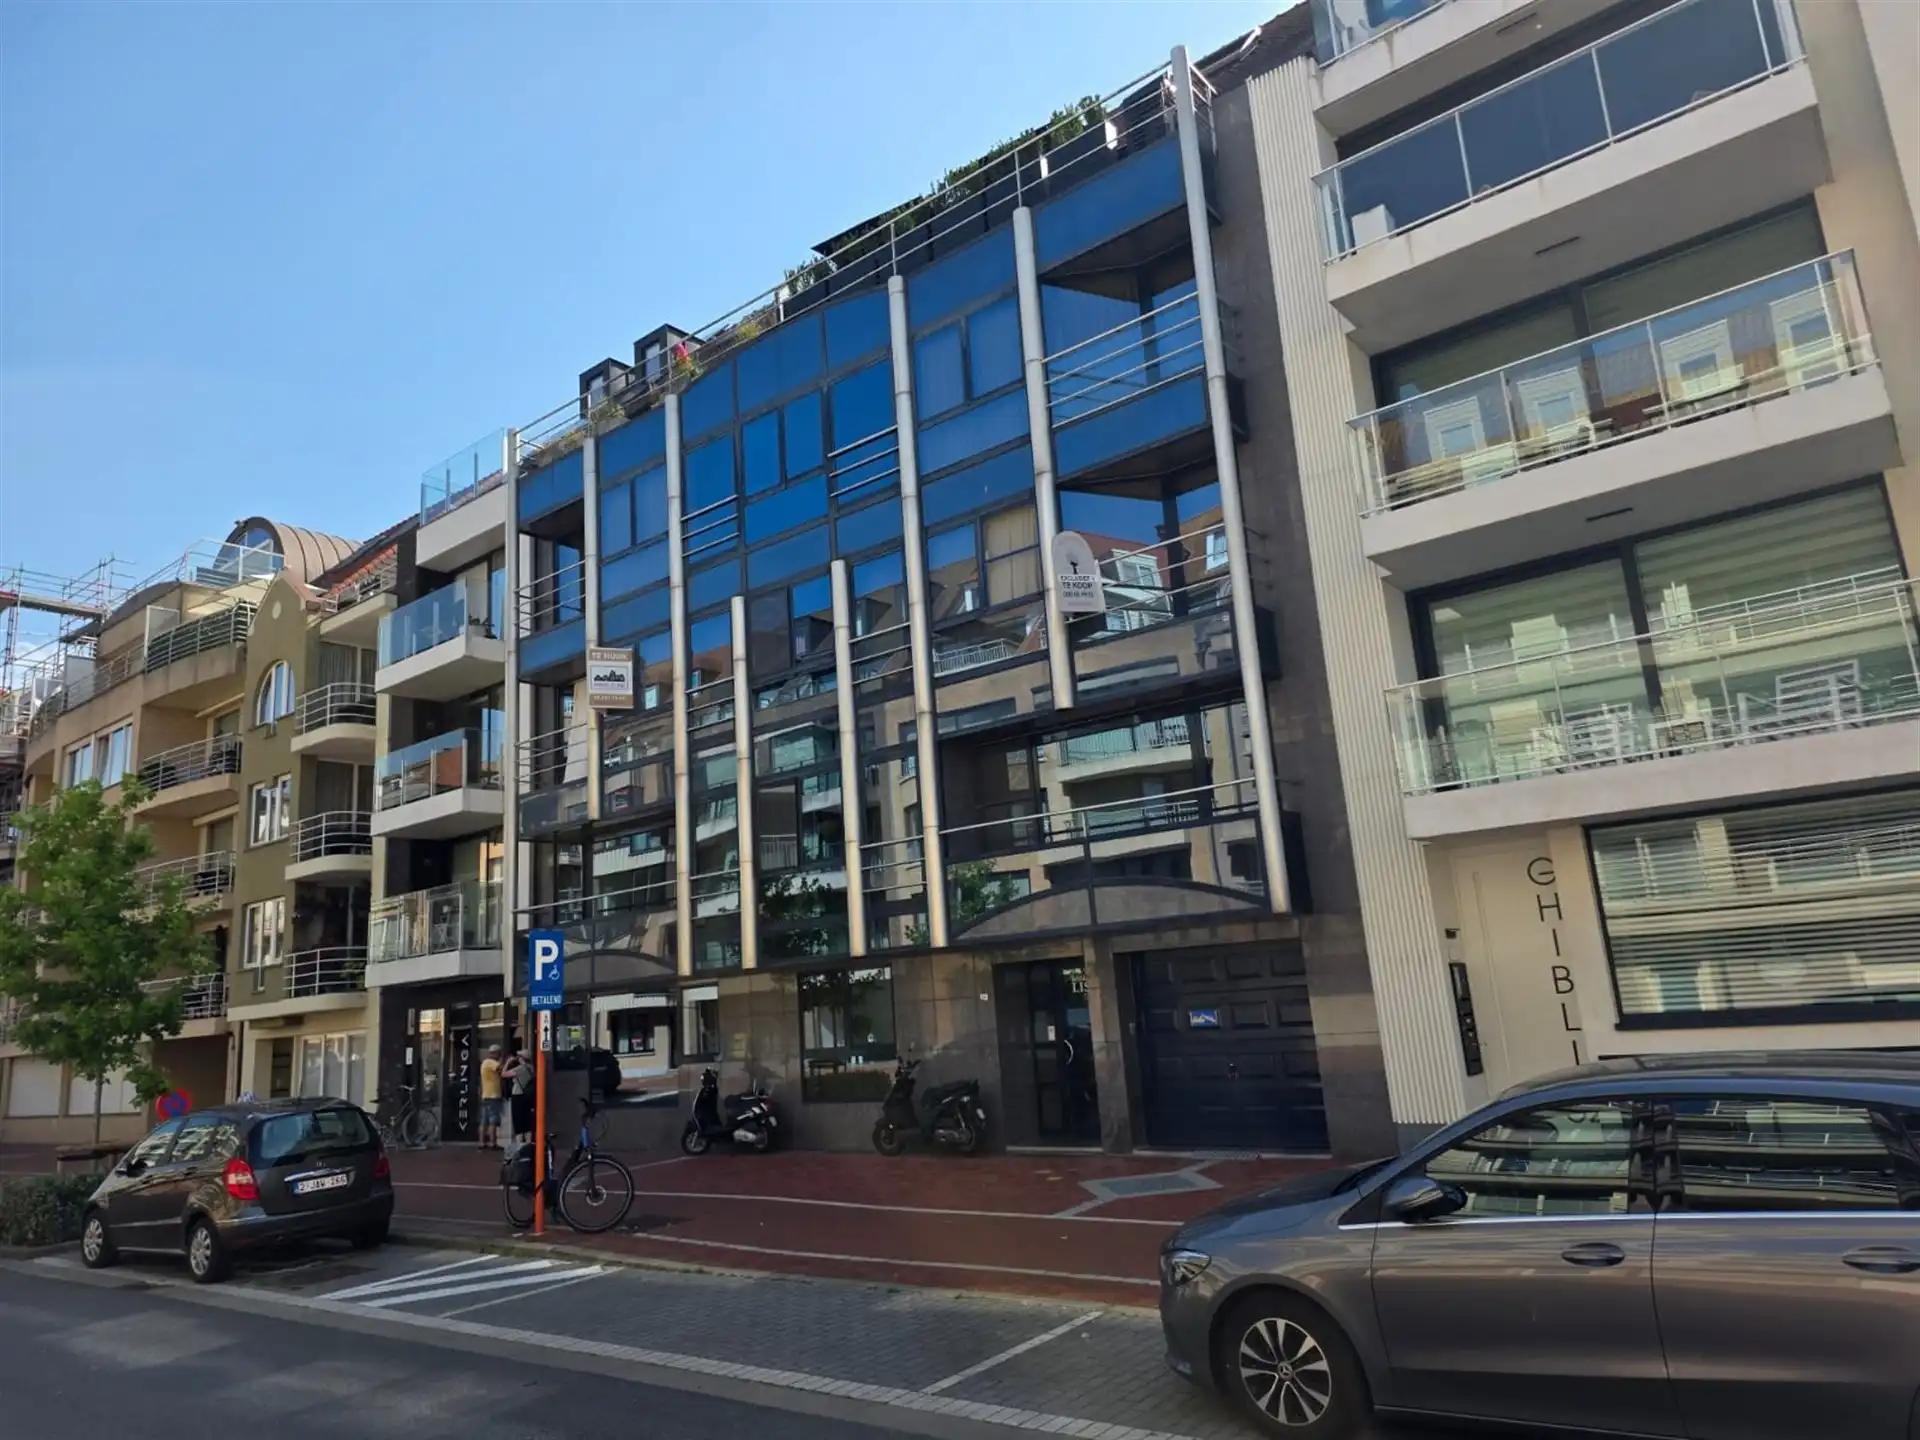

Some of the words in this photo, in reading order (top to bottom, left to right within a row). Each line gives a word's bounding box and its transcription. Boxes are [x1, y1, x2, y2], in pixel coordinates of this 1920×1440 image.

[535, 939, 559, 980] P
[1527, 857, 1582, 1066] GHIBLI
[531, 995, 562, 1006] BETALEND
